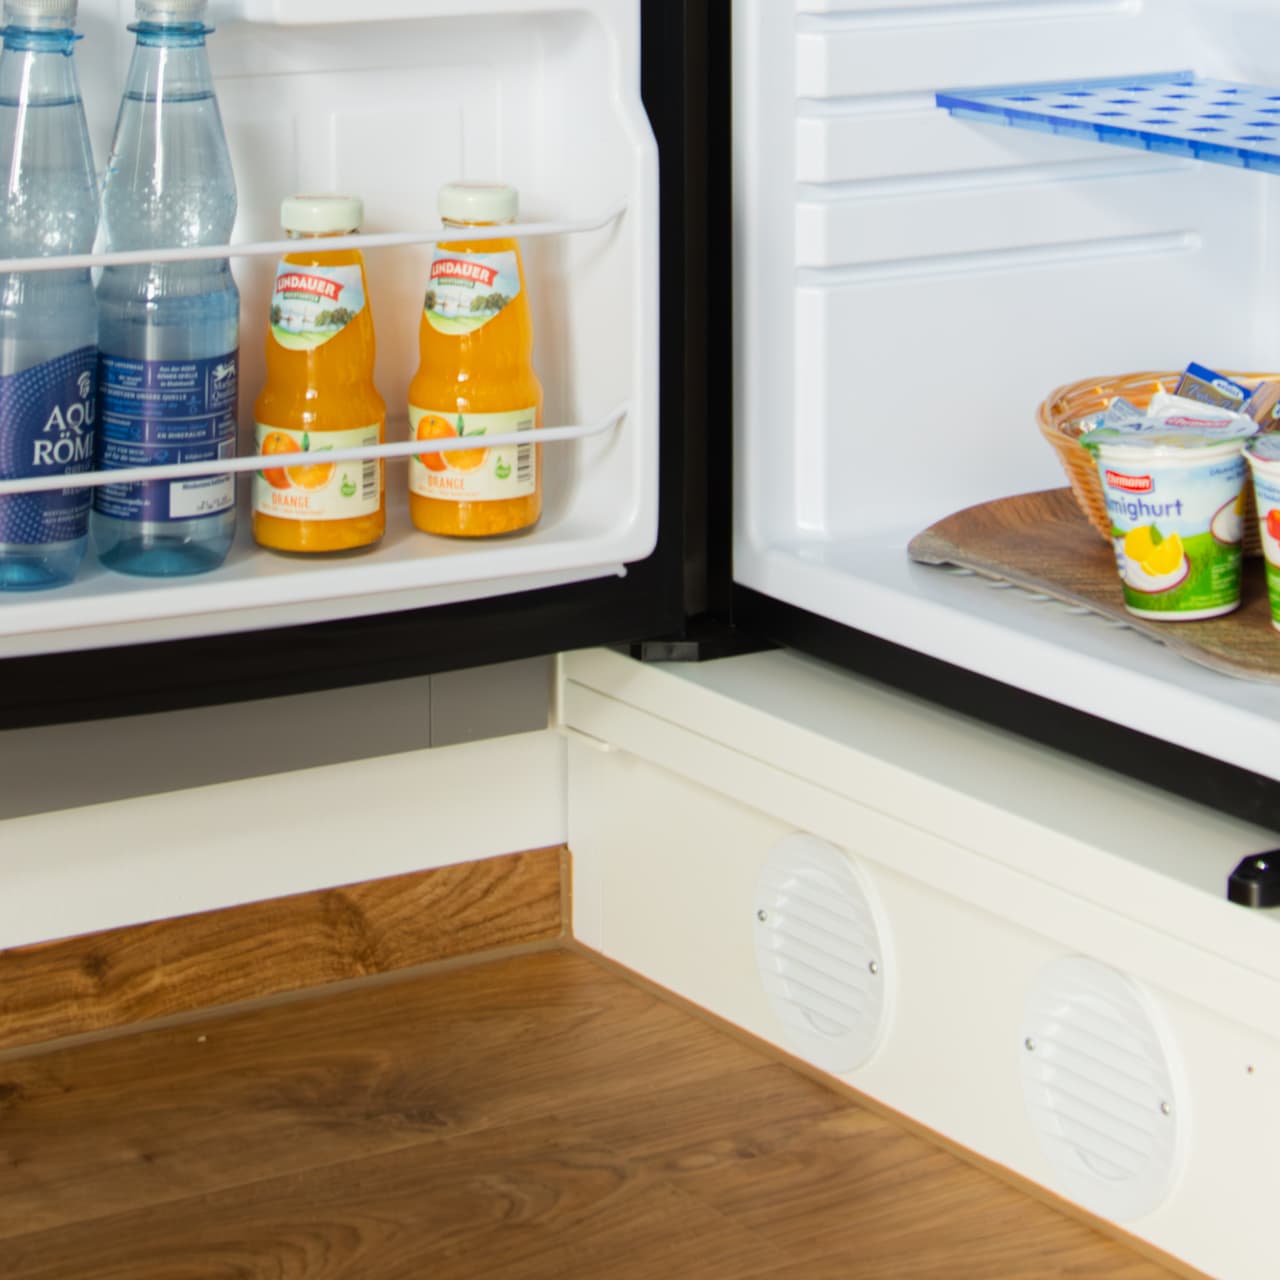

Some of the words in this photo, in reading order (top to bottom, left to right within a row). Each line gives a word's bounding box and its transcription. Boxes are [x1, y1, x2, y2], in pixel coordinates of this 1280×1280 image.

[431, 261, 490, 283] LINDAUER
[277, 274, 336, 297] LINDAUER
[428, 475, 464, 490] ORANGE
[272, 492, 310, 509] ORANGE
